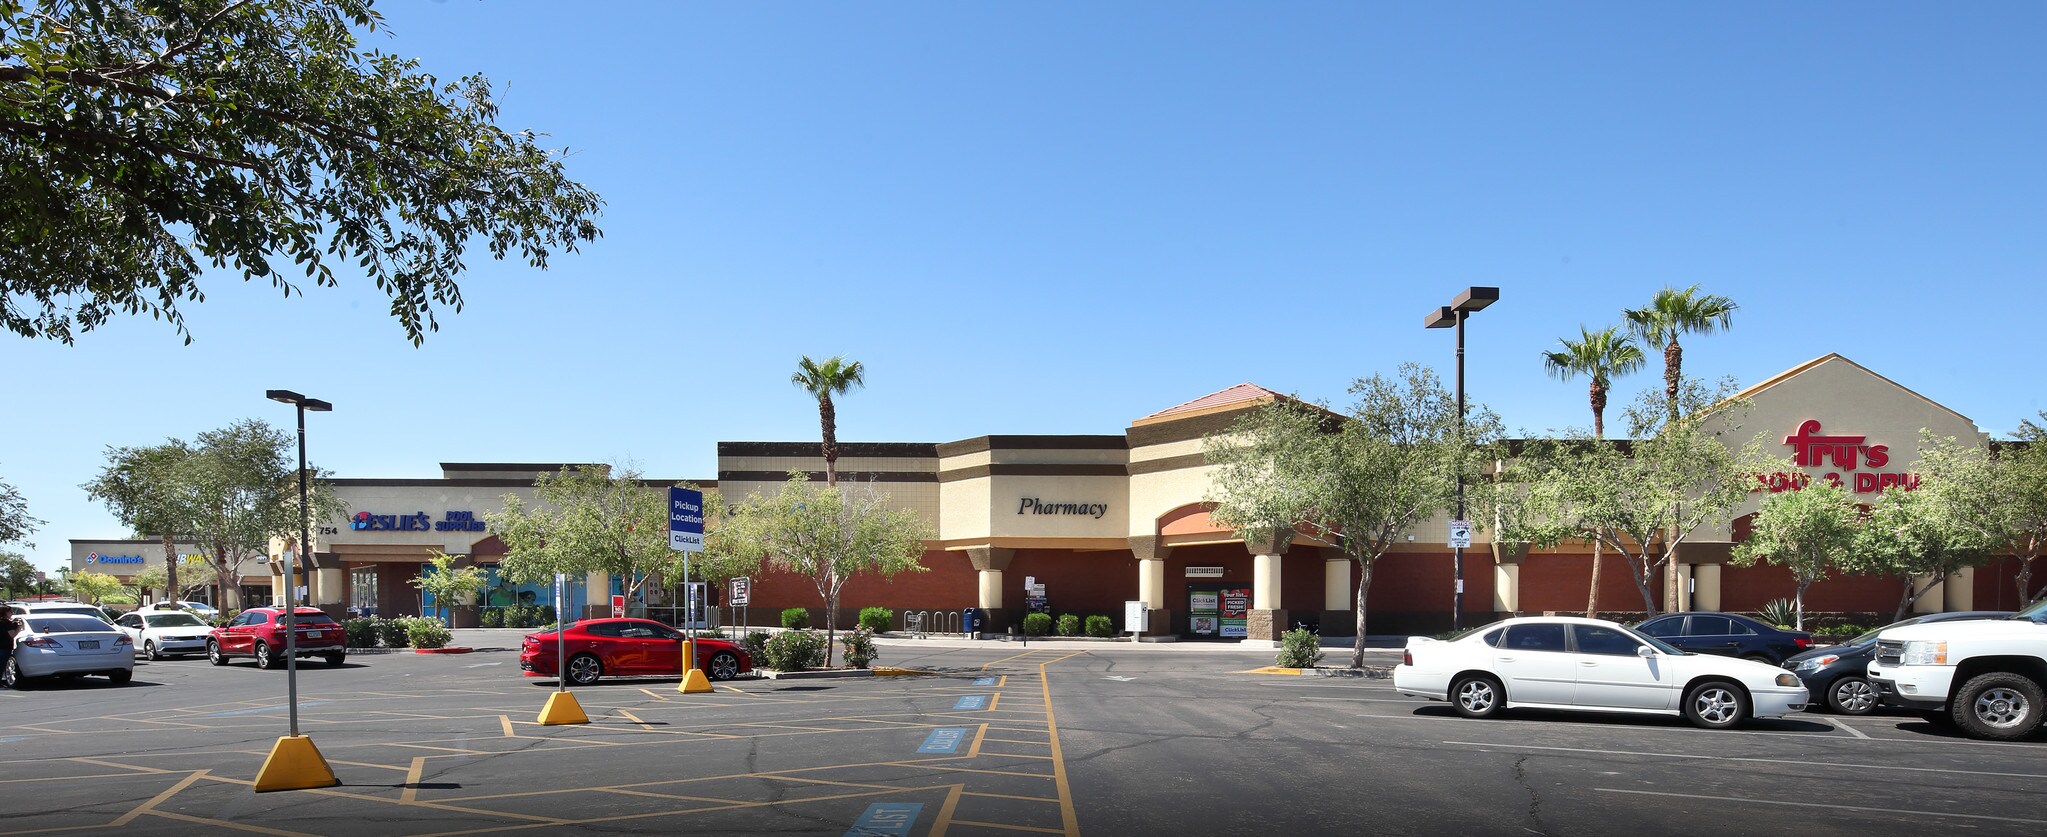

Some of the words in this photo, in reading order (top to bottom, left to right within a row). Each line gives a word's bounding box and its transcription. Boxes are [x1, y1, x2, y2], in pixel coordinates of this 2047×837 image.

[1782, 419, 1889, 472] fry's
[1854, 472, 1921, 493] DRU
[674, 500, 699, 513] Pickup
[1017, 498, 1108, 519] Pharmacy
[353, 511, 431, 532] LESLIE'S
[445, 511, 475, 522] POOL
[671, 511, 703, 524] Location
[319, 527, 338, 535] 754
[435, 521, 486, 532] SUPPLIES
[674, 535, 700, 545] ClickList
[98, 555, 144, 564] Domino's
